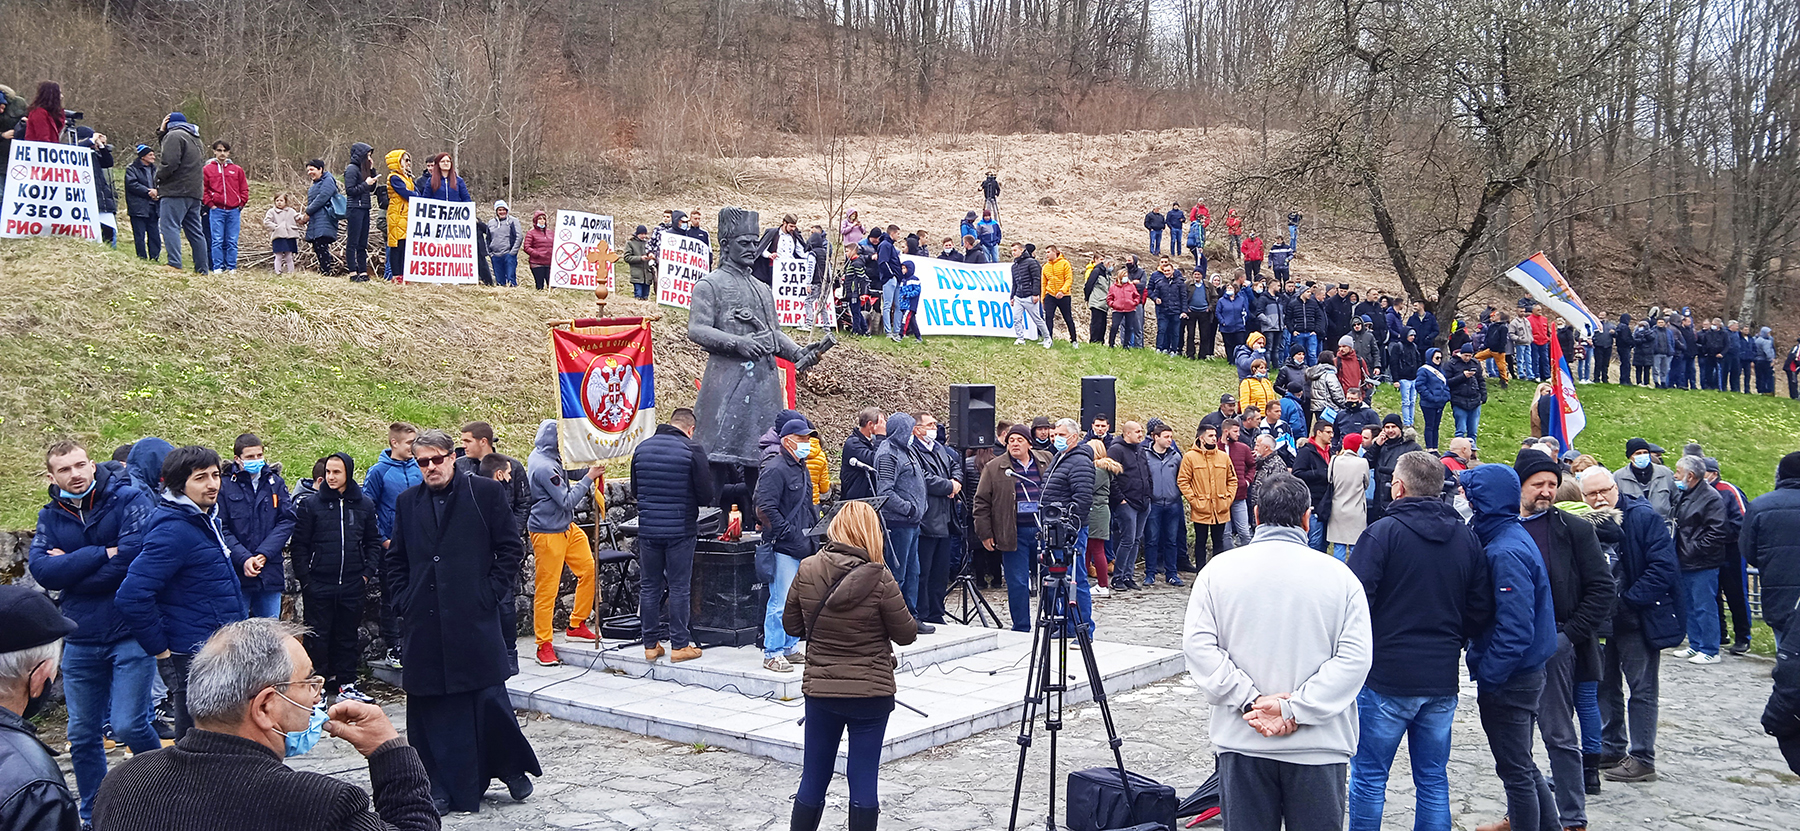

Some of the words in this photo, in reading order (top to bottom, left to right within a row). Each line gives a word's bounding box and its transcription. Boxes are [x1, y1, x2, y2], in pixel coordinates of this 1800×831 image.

[15, 146, 31, 161] НЕ
[38, 147, 89, 167] ПОСТОЈИ
[30, 166, 80, 183] КИНТА
[18, 183, 58, 200] КОЈУ
[65, 187, 87, 202] БИХ
[13, 202, 62, 218] УЗЕО
[71, 207, 91, 222] ОД
[415, 202, 470, 220] НЕЋЕМО
[6, 219, 43, 235] РИО
[51, 223, 95, 239] ТИНТА
[563, 215, 576, 226] ЗА
[413, 222, 430, 239] ДА
[435, 224, 471, 240] БУДЕМО
[582, 231, 589, 243] И
[412, 241, 472, 258] ЕКОЛОШКЕ
[662, 249, 688, 264] НЕЋЕ
[410, 260, 474, 279] ИЗБЕГЛИЦЕ
[667, 264, 706, 281] РУДНИ
[781, 262, 806, 272] ХОЋ
[782, 273, 806, 285] ЗДР
[933, 266, 1010, 293] RUDNIK
[779, 286, 808, 298] СРЕД
[776, 299, 791, 311] НЕ
[923, 294, 976, 326] NEĆE
